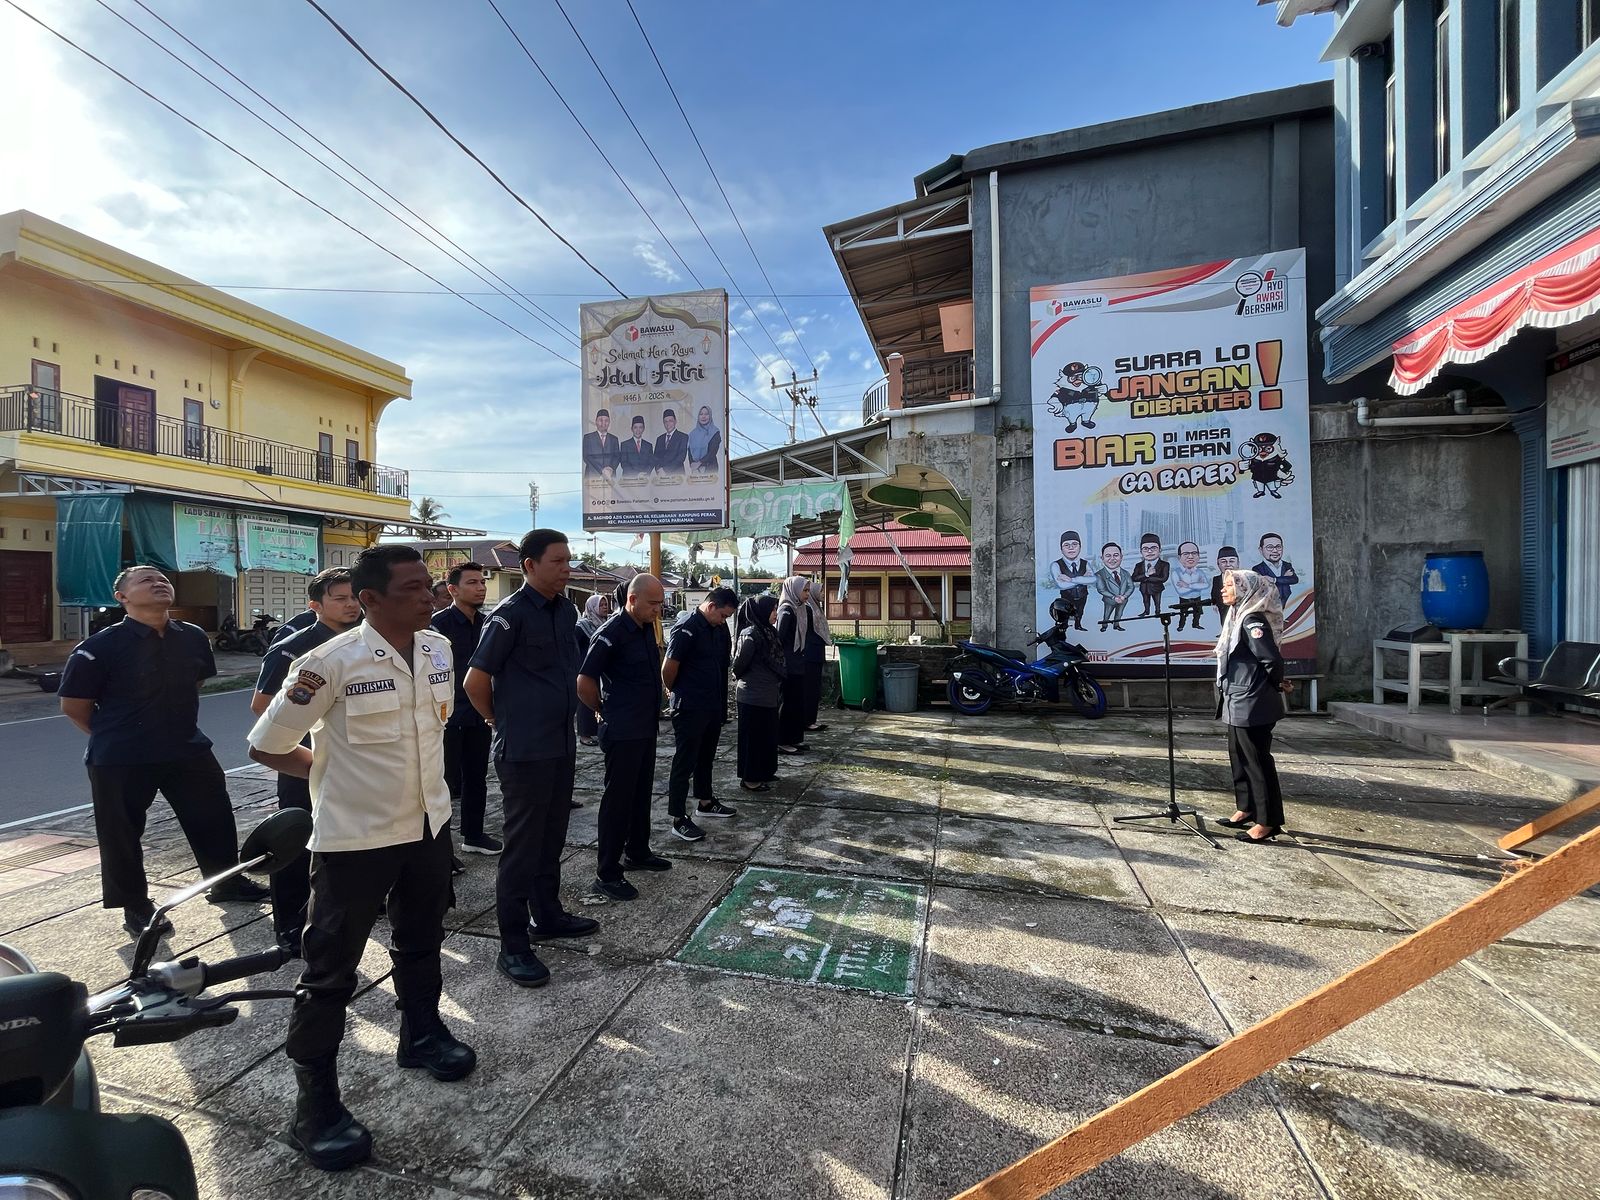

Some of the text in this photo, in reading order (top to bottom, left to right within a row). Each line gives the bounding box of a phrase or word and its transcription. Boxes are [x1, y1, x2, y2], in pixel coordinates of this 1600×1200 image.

[1267, 280, 1283, 291] AYO
[1063, 297, 1102, 307] BAWASLU
[1256, 291, 1283, 303] AWASI
[1244, 301, 1284, 315] BERSAMA
[640, 325, 675, 333] BAWASLU
[605, 342, 695, 364] Selamat Hari Raya
[1115, 344, 1250, 373] SUARA LO
[1107, 363, 1251, 402] JANGAN
[649, 391, 665, 400] 2025
[1131, 391, 1251, 419] DIBARTER
[1163, 428, 1231, 443] DI MASA
[1053, 432, 1156, 470] BIAR
[1163, 441, 1231, 459] DEPAN
[1119, 463, 1236, 494] GA BAPER
[300, 670, 323, 685] POLDA
[349, 681, 395, 694] YURISMAN
